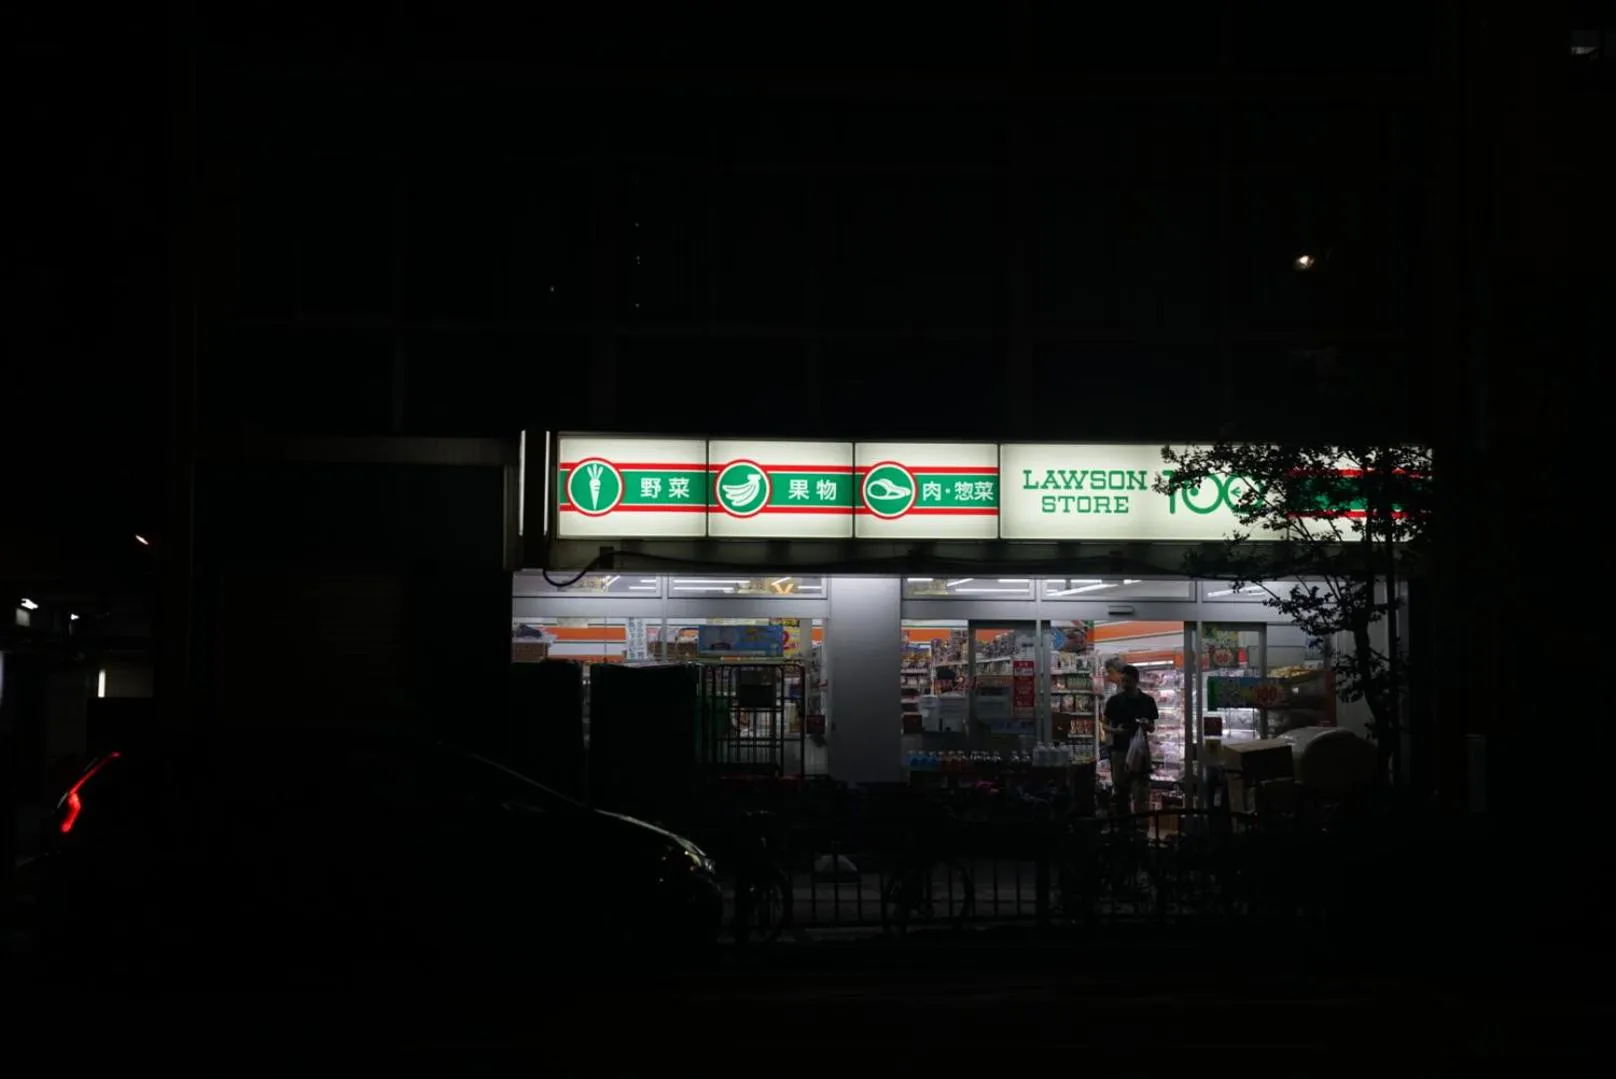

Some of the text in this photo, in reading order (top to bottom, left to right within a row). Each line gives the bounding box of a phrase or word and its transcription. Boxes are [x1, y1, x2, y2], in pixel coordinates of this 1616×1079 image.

[640, 477, 690, 499] 野菜
[789, 479, 837, 501] 果物
[1023, 469, 1147, 490] LAWSON
[1041, 495, 1130, 514] STORE
